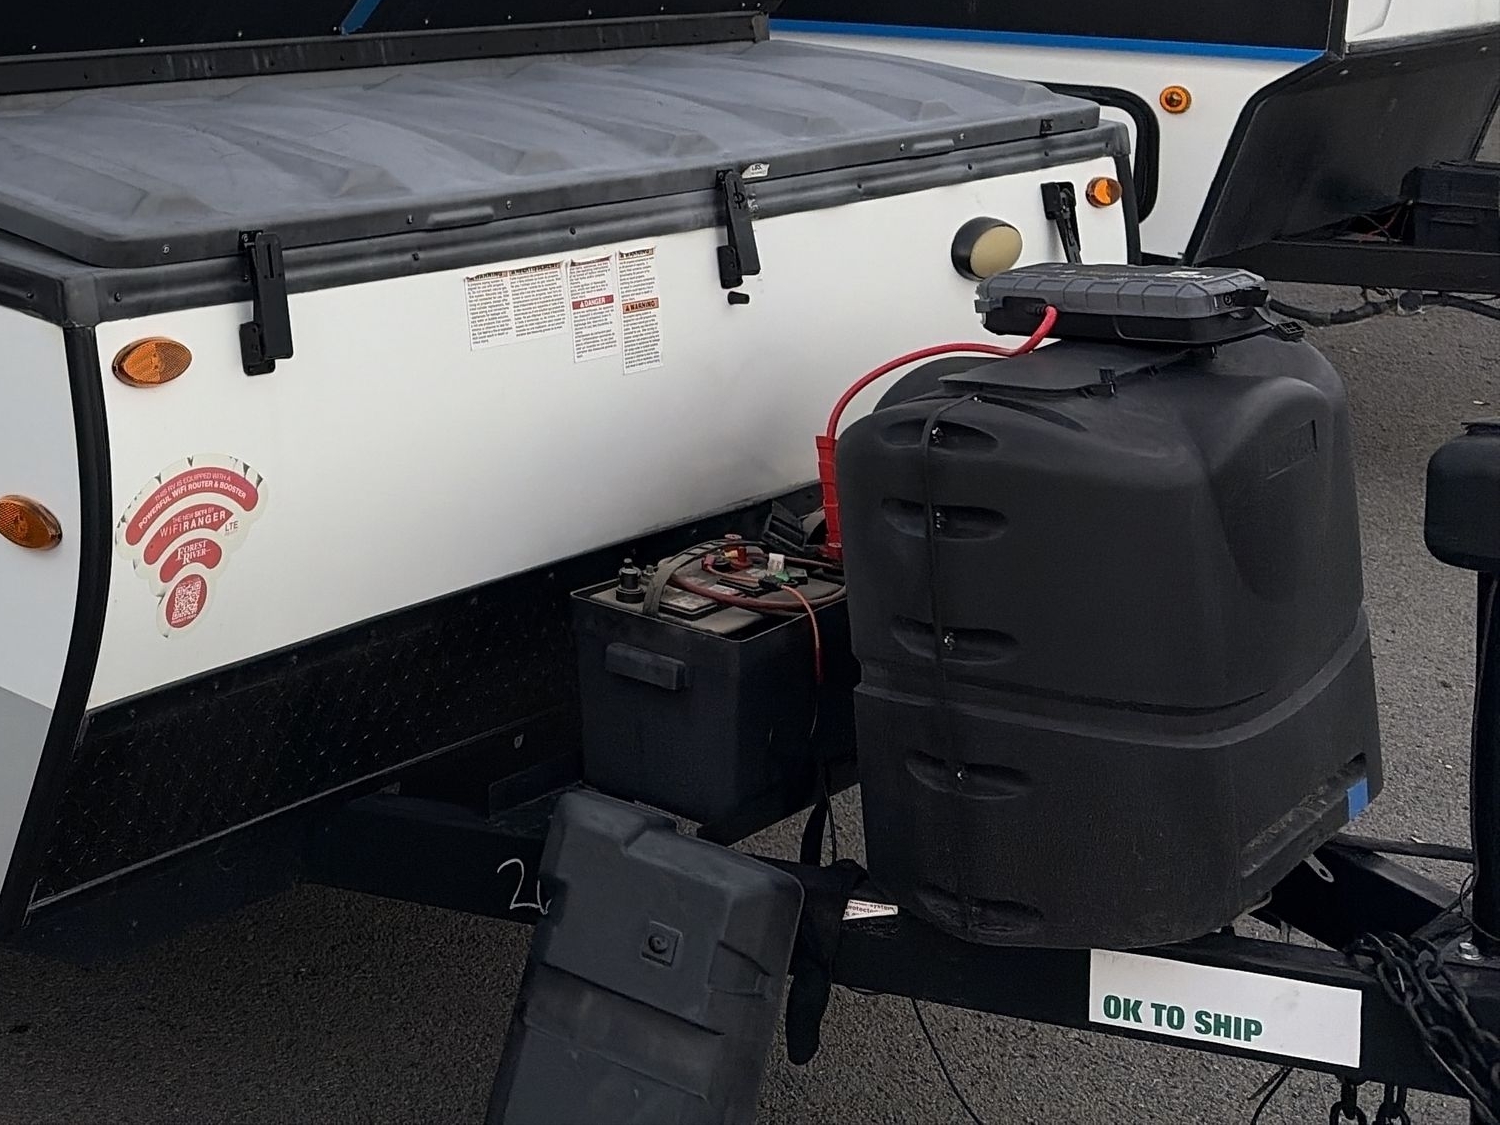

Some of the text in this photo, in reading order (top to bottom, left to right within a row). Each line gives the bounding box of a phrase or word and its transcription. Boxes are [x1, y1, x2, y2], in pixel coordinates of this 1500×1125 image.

[584, 297, 606, 307] DANGER
[630, 300, 656, 311] WARNING
[138, 480, 247, 529] POWERFUL WIFI ROUTER & BOOSTER
[160, 510, 226, 538] WIFIRANGER
[225, 520, 239, 532] LTE
[175, 539, 208, 562] FOREST
[182, 548, 207, 565] RIVER
[1103, 994, 1263, 1042] OK TO SHIP
